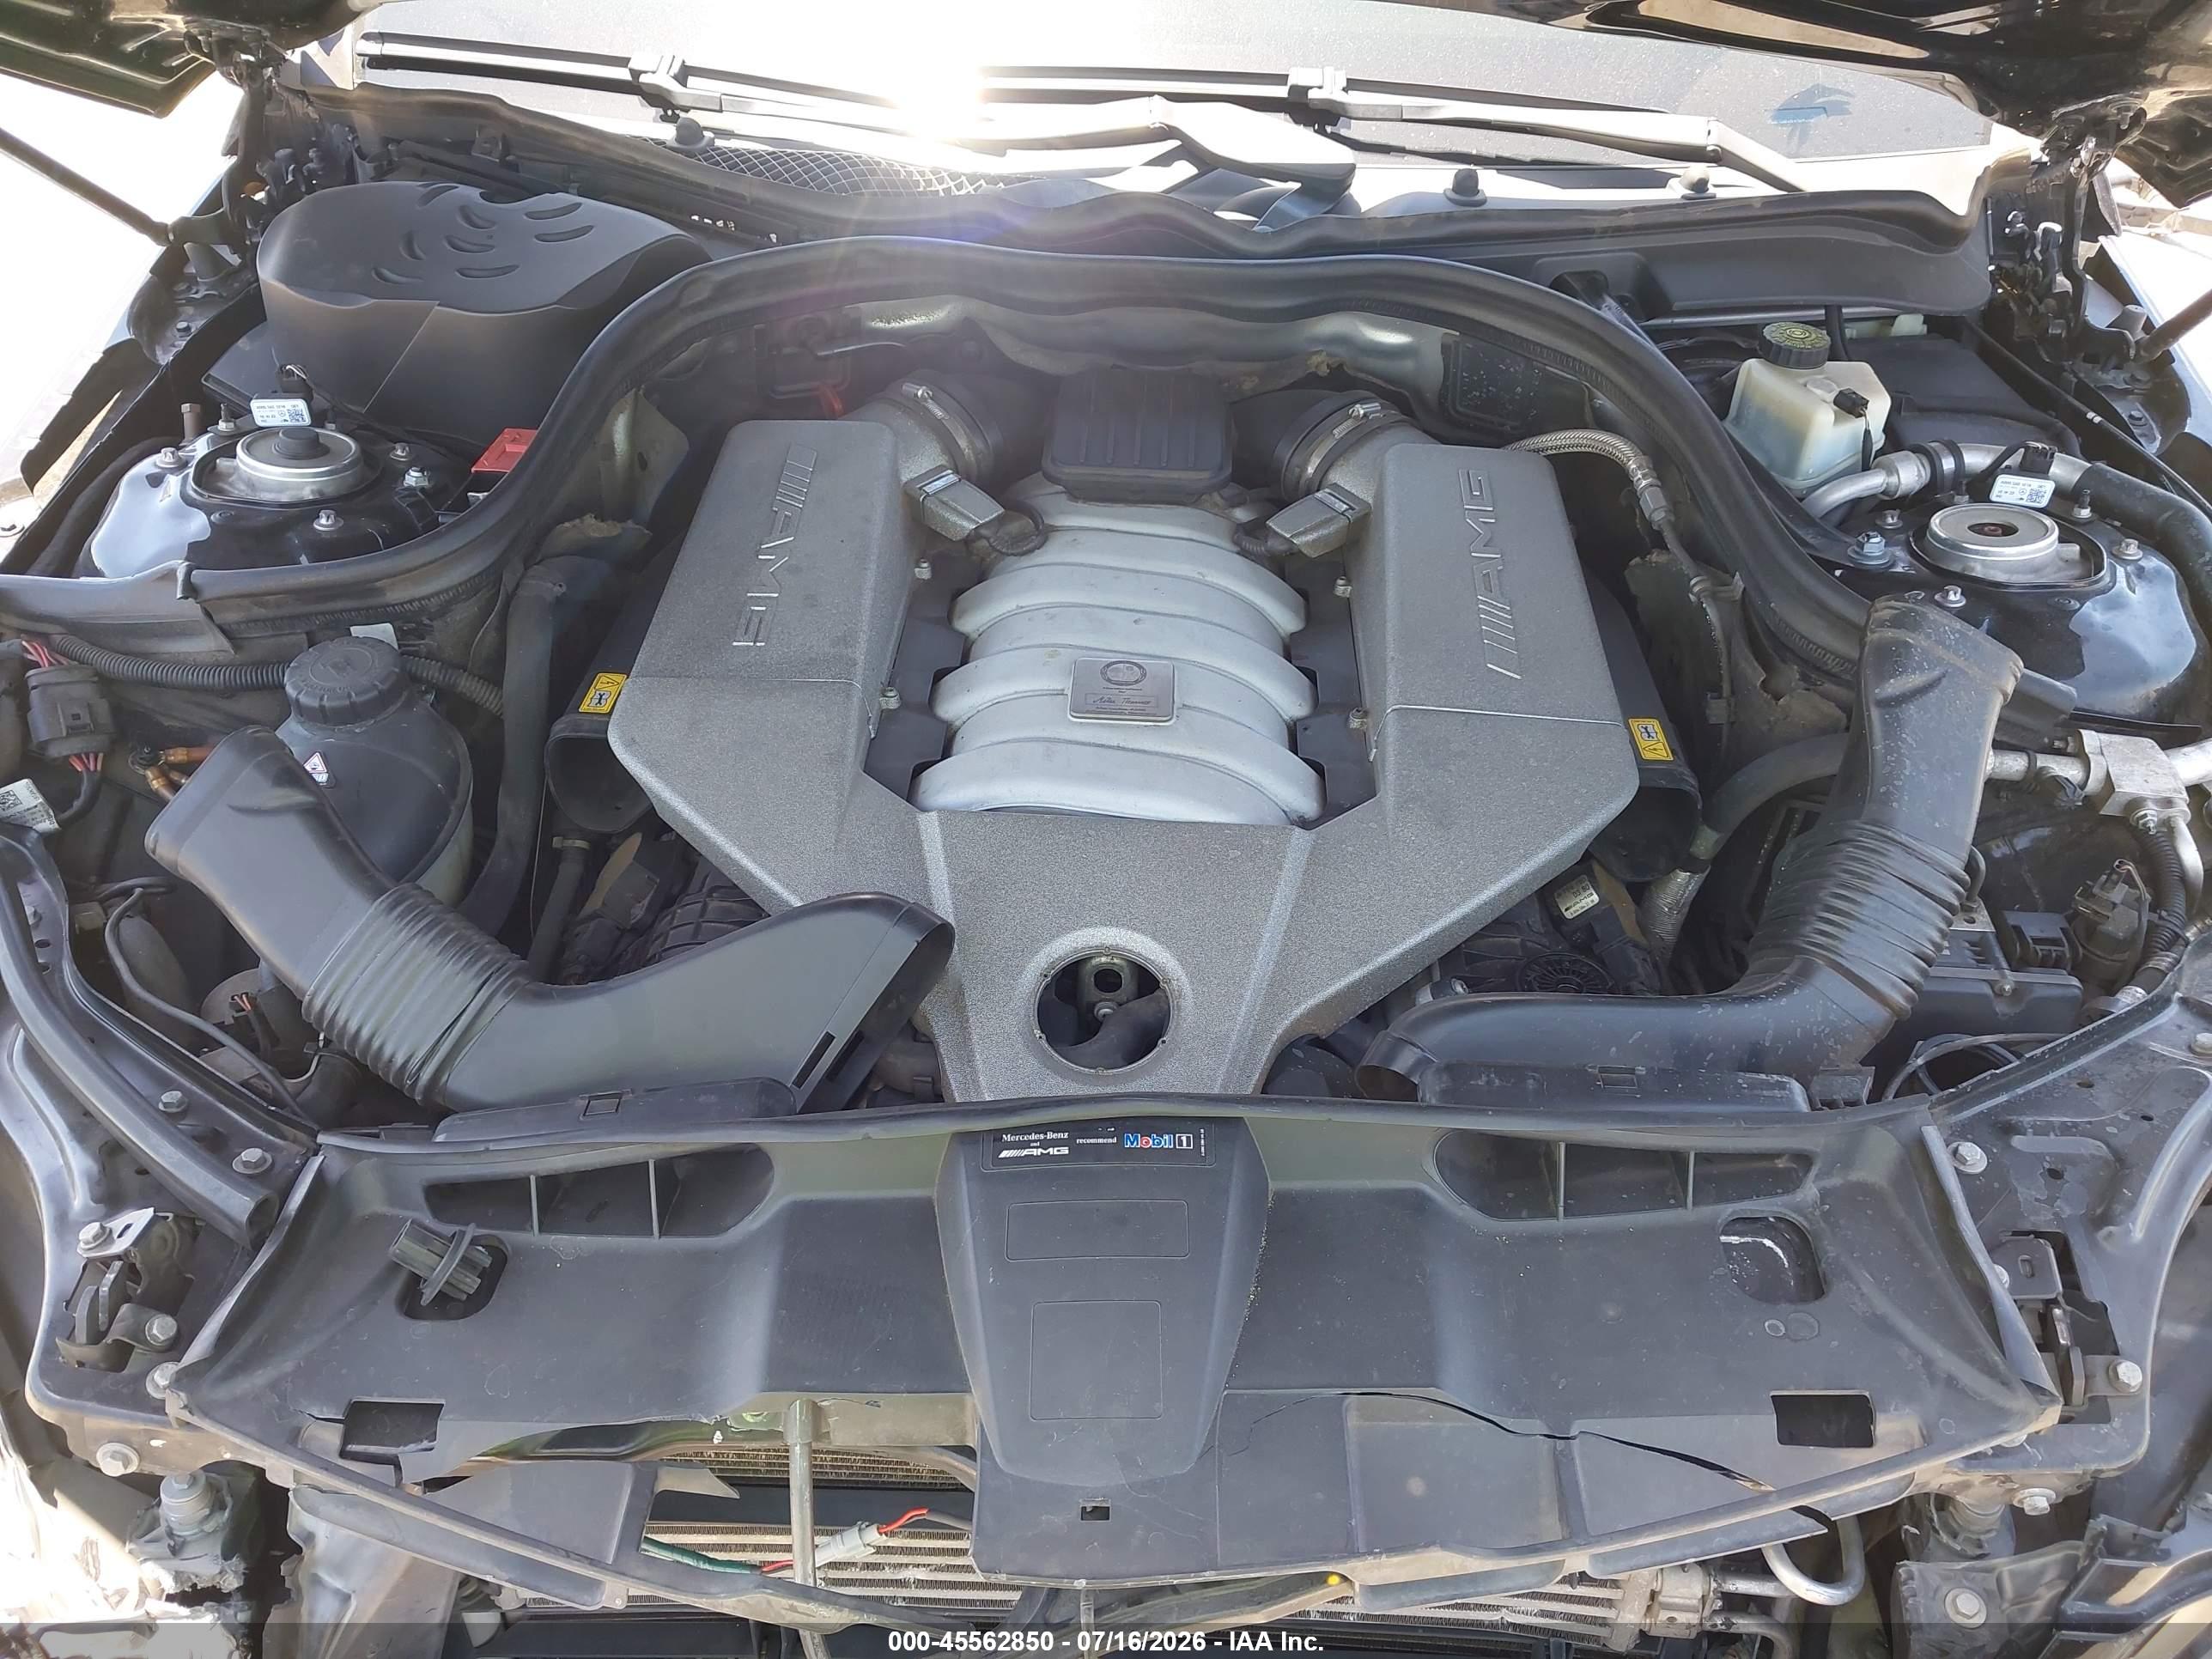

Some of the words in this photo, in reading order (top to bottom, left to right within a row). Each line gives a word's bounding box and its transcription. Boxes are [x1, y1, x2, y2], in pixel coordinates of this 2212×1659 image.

[1458, 469, 1511, 618] AMG
[732, 496, 803, 646] AMG
[1002, 1131, 1069, 1142] Mercedes-Benz
[1076, 1136, 1117, 1145] recommend
[1124, 1133, 1174, 1149] Mobil
[1020, 1146, 1069, 1157] AMG
